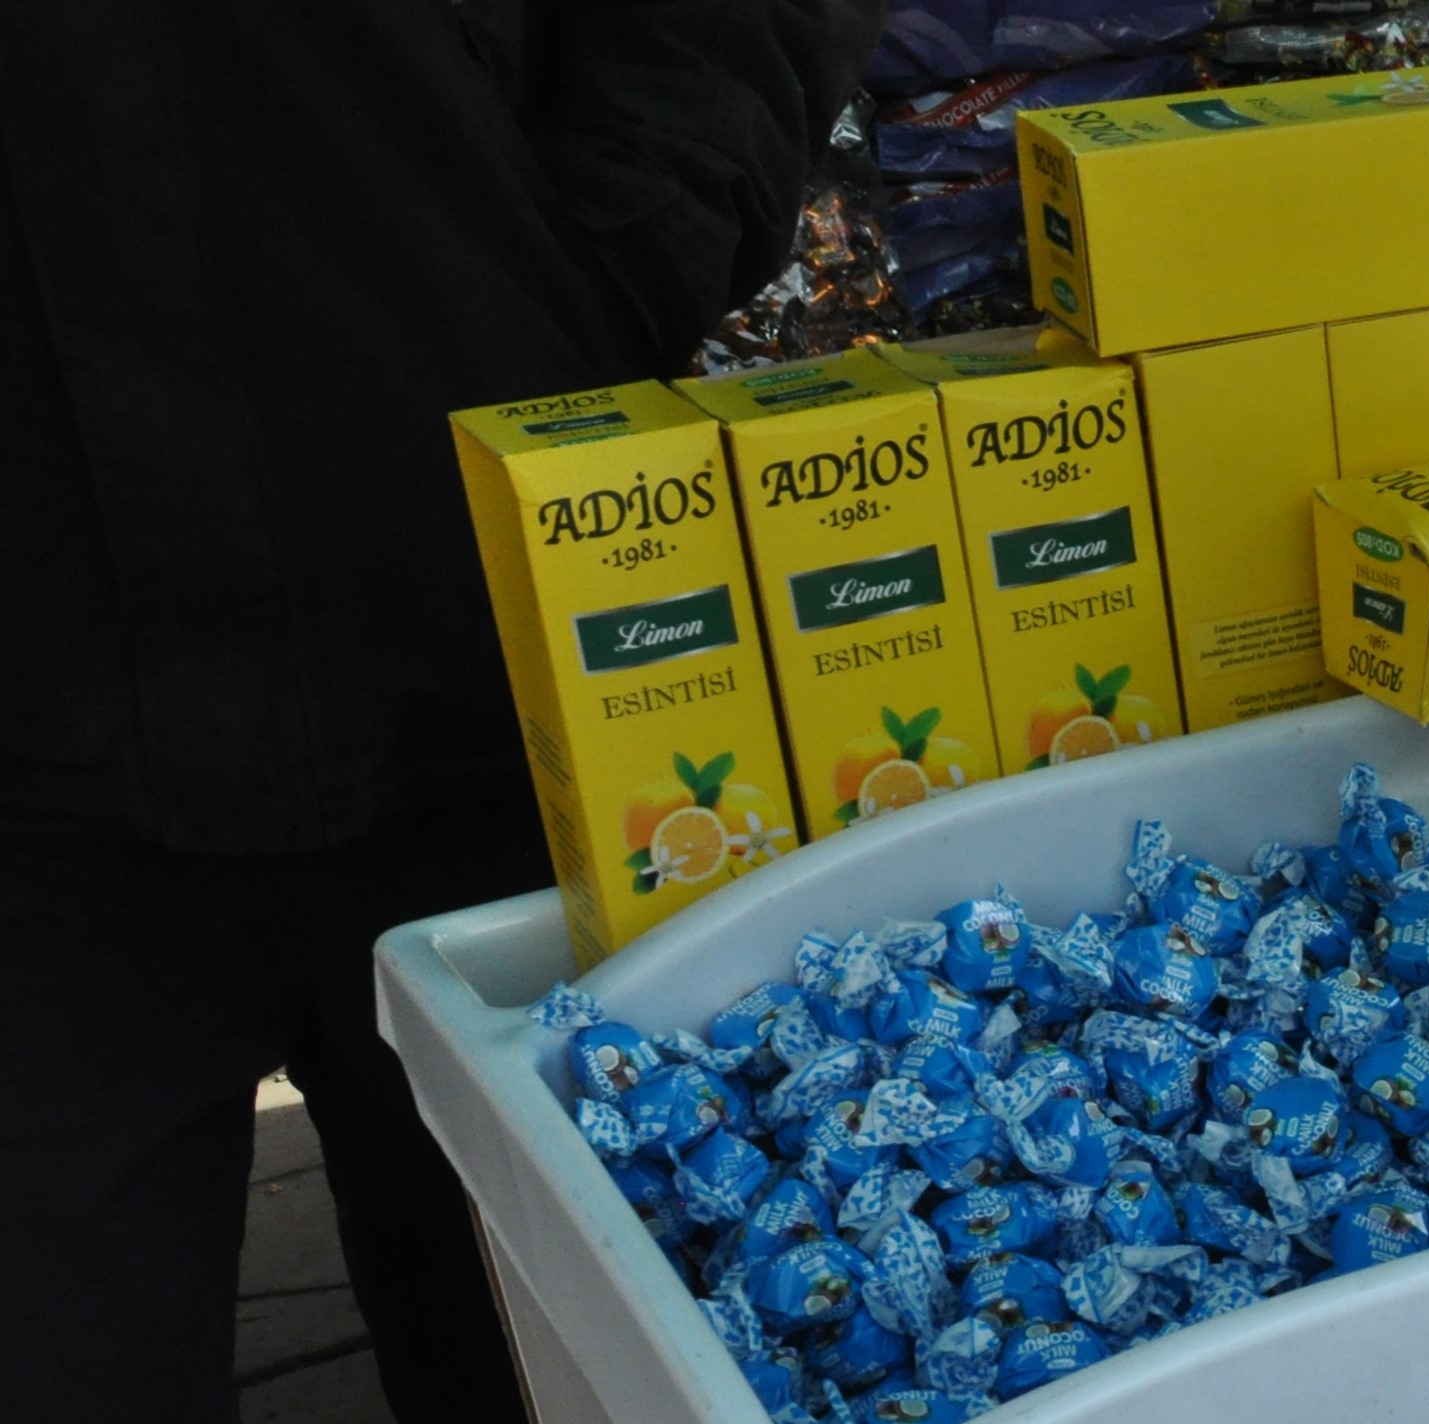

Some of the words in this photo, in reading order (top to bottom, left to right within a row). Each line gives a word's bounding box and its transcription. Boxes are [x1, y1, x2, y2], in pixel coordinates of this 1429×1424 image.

[1025, 535, 1108, 571] Limon
[826, 574, 912, 611] Limon
[1011, 584, 1136, 633] ESİNTİSİ
[614, 614, 704, 654] Limon
[814, 623, 944, 678] ESİNTİSİ
[602, 666, 738, 721] ESİNTİSİ
[1414, 914, 1426, 948] MILK
[925, 1015, 961, 1038] MILK
